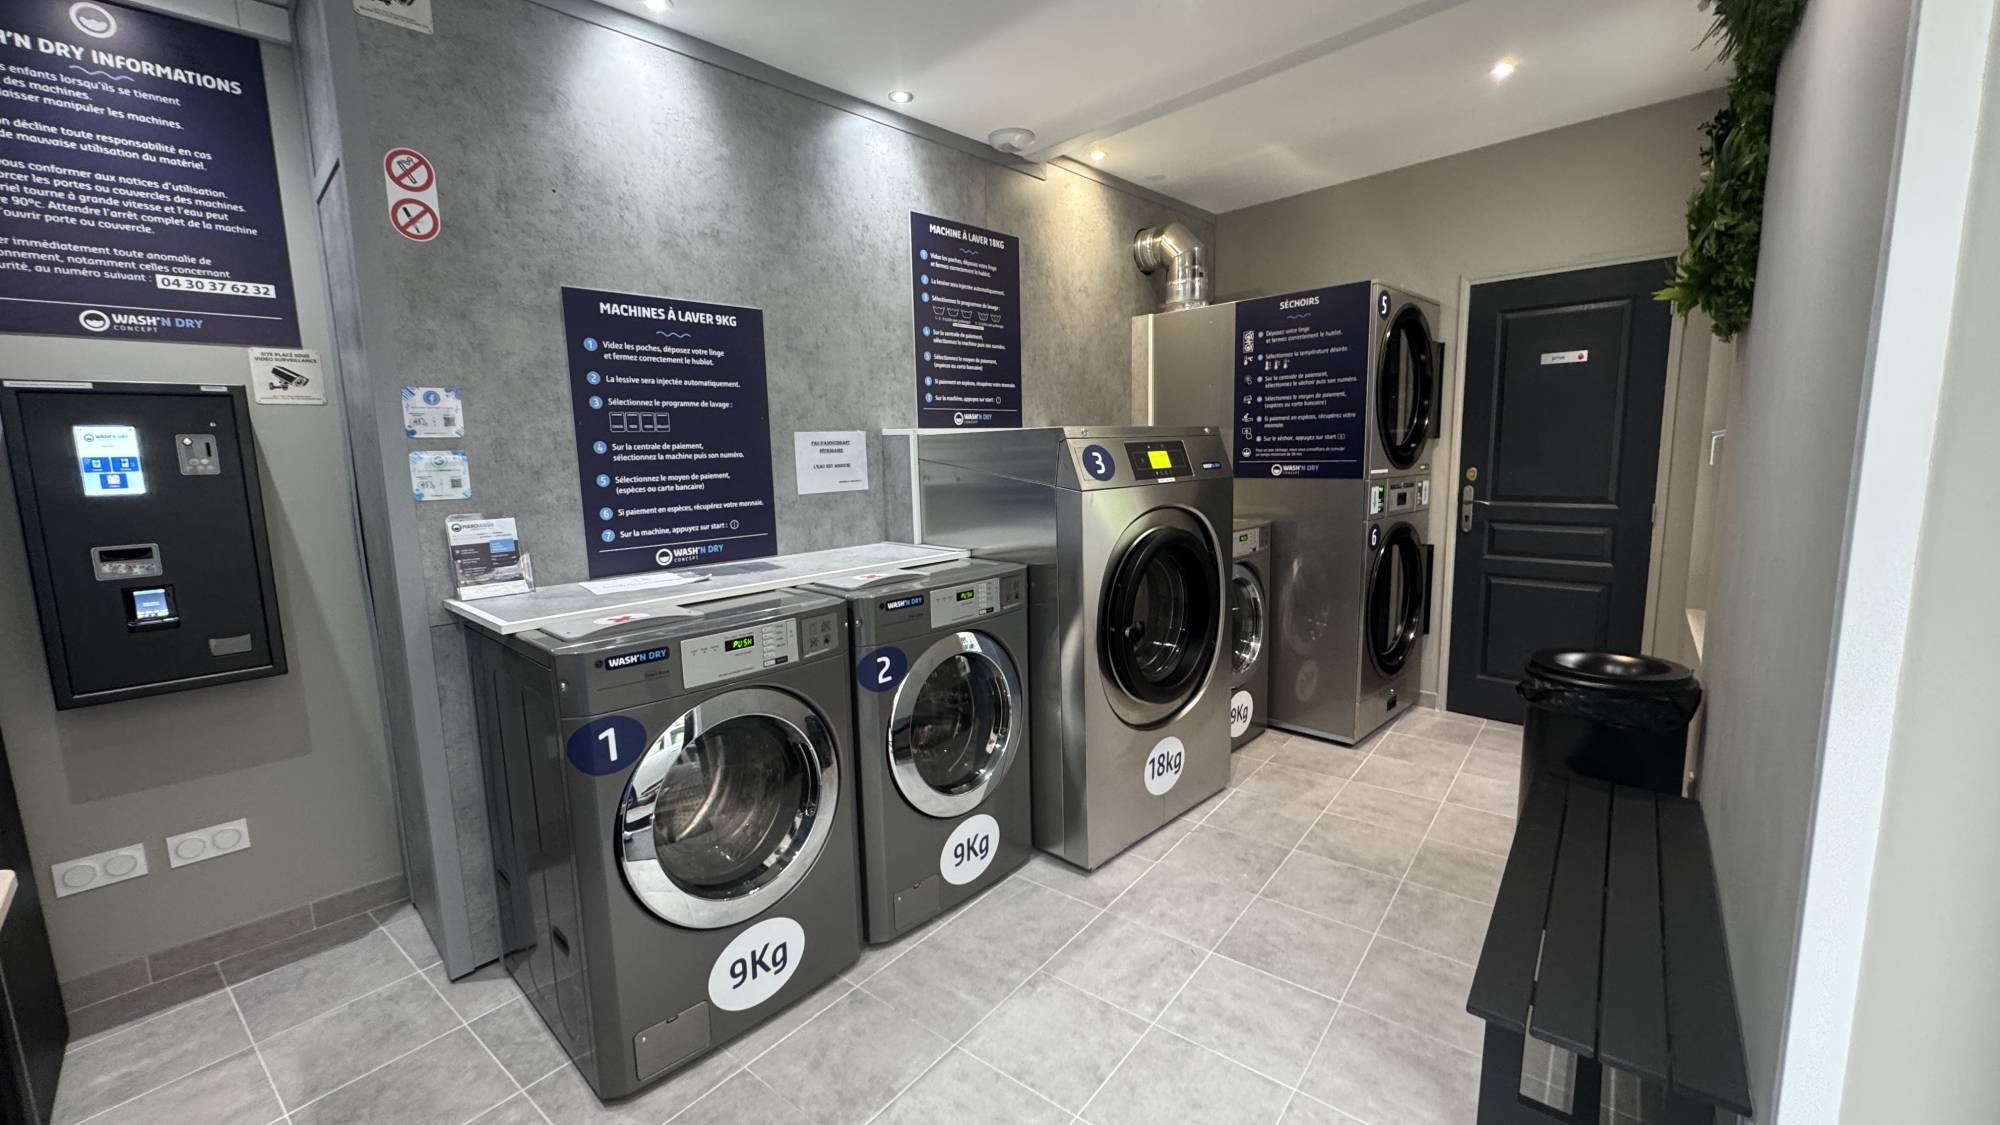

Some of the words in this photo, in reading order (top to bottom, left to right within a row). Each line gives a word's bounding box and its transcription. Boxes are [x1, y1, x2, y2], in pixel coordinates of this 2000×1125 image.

[38, 38, 84, 61] DRY
[92, 49, 242, 95] INFORMATIONS
[4, 75, 26, 89] des
[28, 82, 94, 100] machines.
[8, 65, 58, 81] enfants
[60, 72, 116, 93] lorsqu'ils
[116, 86, 132, 96] se
[132, 88, 182, 106] tiennent
[42, 97, 104, 115] manipuler
[106, 106, 124, 119] les
[126, 112, 184, 129] machines.
[12, 117, 58, 134] décline
[60, 126, 94, 140] toute
[96, 133, 176, 154] responsabilité
[178, 147, 192, 156] en
[194, 150, 212, 160] cas
[16, 132, 78, 149] mauvaise
[80, 142, 140, 159] utilisation
[142, 150, 156, 162] du
[158, 155, 208, 170] matériel.
[28, 163, 92, 178] conformer
[94, 172, 116, 182] aux
[118, 175, 160, 188] notices
[162, 179, 228, 198] d'utilisation.
[30, 171, 50, 184] les
[52, 177, 92, 190] portes
[94, 183, 110, 192] ou
[112, 186, 172, 201] couvercles
[174, 192, 192, 204] des
[194, 198, 248, 212] machines.
[22, 185, 66, 199] tourne
[68, 189, 76, 200] à
[78, 194, 120, 206] grande
[122, 198, 162, 212] vitesse
[164, 204, 176, 214] et
[176, 204, 204, 217] l'eau
[206, 211, 230, 221] peut
[44, 213, 78, 224] porte
[80, 217, 96, 226] ou
[98, 220, 156, 234] couvercle.
[48, 200, 102, 216] Attendre
[102, 206, 138, 220] l'arrêt
[140, 214, 186, 226] complet
[186, 217, 202, 228] de
[202, 219, 212, 230] la
[214, 223, 258, 235] machine
[930, 224, 961, 240] MACHINE
[962, 229, 967, 241] À
[968, 233, 988, 246] LAVER
[989, 238, 1005, 250] 18KG
[12, 236, 110, 255] immédiatement
[112, 247, 144, 258] toute
[146, 252, 196, 264] anomalie
[198, 254, 212, 265] de
[34, 265, 50, 273] au
[54, 265, 100, 277] numéro
[104, 269, 146, 281] suivant
[66, 255, 138, 269] notamment
[138, 260, 170, 272] celles
[172, 265, 230, 278] concernant
[160, 277, 182, 288] 04
[186, 279, 204, 290] 30
[208, 281, 228, 292] 37
[230, 283, 250, 294] 62
[252, 285, 270, 296] 32
[1280, 296, 1320, 310] SÉCHOIRS
[1382, 296, 1388, 314] 5
[110, 313, 170, 327] WASH'N
[174, 317, 204, 328] DRY
[600, 302, 666, 320] MACHINES
[667, 305, 676, 321] À
[678, 309, 713, 324] LAVER
[716, 313, 737, 326] 9KG
[602, 341, 624, 350] Videz
[624, 342, 634, 351] les
[636, 343, 662, 354] poches,
[663, 344, 690, 356] déposez
[691, 347, 708, 355] votre
[708, 347, 724, 358] linge
[613, 351, 638, 361] fermez
[639, 355, 684, 364] correctement
[684, 356, 691, 364] le
[691, 356, 714, 366] hublot.
[606, 375, 615, 383] La
[616, 375, 640, 384] lessive
[656, 376, 683, 387] injectée
[683, 378, 740, 389] automatiquement.
[608, 397, 653, 406] Sélectionnez
[654, 398, 661, 406] le
[662, 400, 700, 409] programme
[700, 399, 709, 407] de
[710, 399, 729, 410] lavage
[612, 443, 625, 451] Sur
[625, 443, 632, 451] la
[633, 442, 660, 450] centrale
[662, 442, 670, 450] de
[672, 442, 704, 452] paiement,
[613, 453, 656, 461] sélectionnez
[658, 452, 665, 460] la
[665, 451, 693, 460] machine
[694, 451, 707, 461] puis
[720, 449, 744, 458] numéro.
[1092, 452, 1106, 474] 3
[615, 475, 659, 484] Sélectionnez
[668, 474, 690, 483] moyen
[691, 472, 699, 480] de
[700, 471, 730, 482] paiement,
[616, 484, 646, 495] (espèces
[657, 484, 674, 492] carte
[675, 482, 705, 491] bancaire)
[618, 508, 625, 517] Si
[626, 507, 657, 518] paiement
[667, 504, 692, 515] espèces,
[693, 501, 722, 512] récupérez
[723, 501, 737, 509] votre
[738, 498, 764, 508] monnaie.
[620, 530, 632, 538] Sur
[633, 529, 640, 537] la
[640, 527, 671, 536] machine,
[672, 525, 699, 535] appuyez
[711, 521, 725, 530] start
[1372, 528, 1377, 546] 6
[673, 545, 707, 557] WASH'N
[708, 543, 724, 553] DRY
[887, 599, 910, 610] WASH'N
[911, 597, 922, 606] DRY
[732, 638, 752, 649] PUSH
[608, 652, 646, 668] WASH'N
[648, 649, 666, 660] DRY
[876, 656, 892, 684] 2
[1231, 704, 1248, 724] 9Kg
[598, 727, 618, 762] 1
[1148, 750, 1182, 780] 18kg
[954, 833, 990, 868] 9Kg
[729, 941, 788, 990] 9Kg
